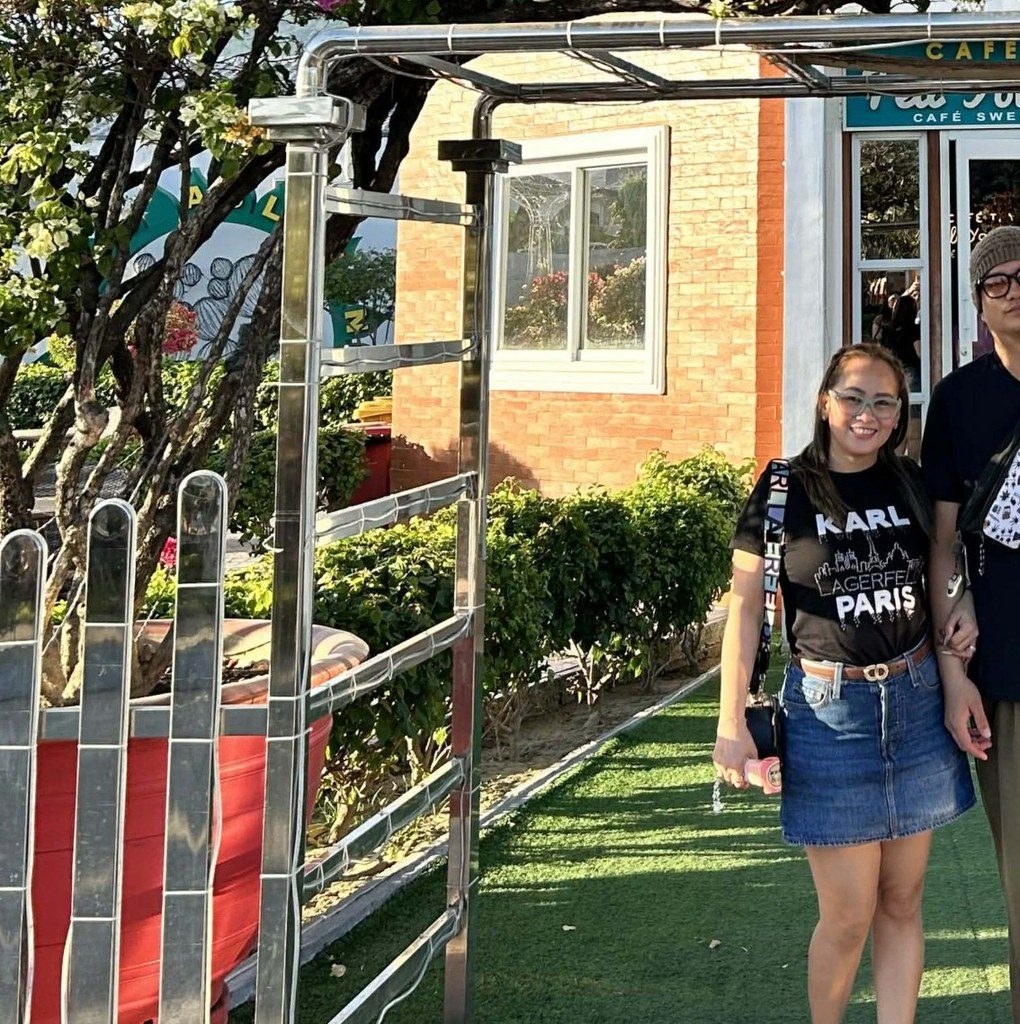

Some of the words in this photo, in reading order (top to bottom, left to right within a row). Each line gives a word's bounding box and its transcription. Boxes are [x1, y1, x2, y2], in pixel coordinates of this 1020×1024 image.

[926, 41, 1016, 60] CAFE
[913, 110, 962, 122] CAFÉ
[815, 505, 911, 536] KARL
[836, 585, 916, 620] PARIS
